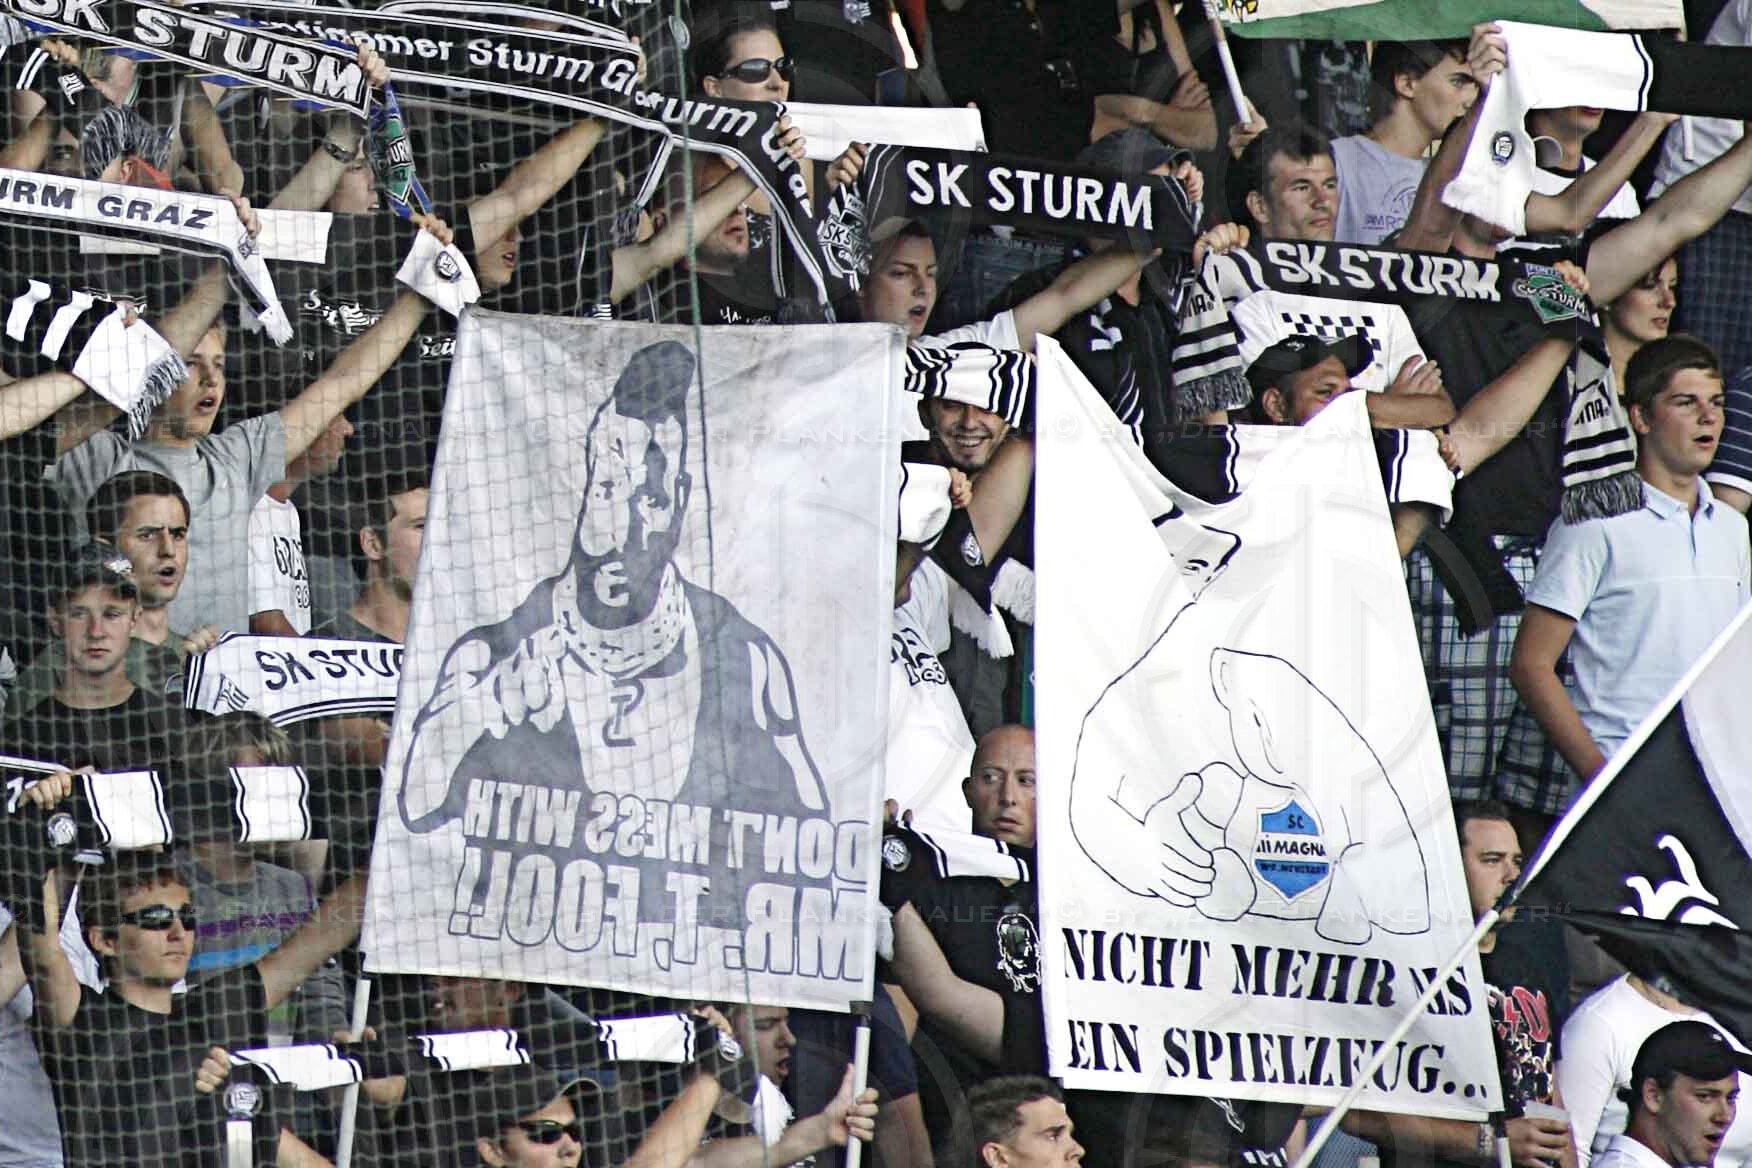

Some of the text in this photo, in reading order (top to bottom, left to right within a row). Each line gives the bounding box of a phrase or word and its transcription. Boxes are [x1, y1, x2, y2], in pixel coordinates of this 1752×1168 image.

[135, 9, 370, 117] STURM
[469, 38, 595, 85] Sturm
[96, 193, 217, 231] GRAZ
[908, 159, 1157, 231] SK STURM
[1268, 243, 1500, 303] SK STURM
[254, 649, 315, 691] SK
[1286, 814, 1305, 830] SC
[1062, 926, 1211, 991] NICHT
[1230, 943, 1397, 1006] MEHR
[1068, 1020, 1489, 1100] EIN SPIELZEUG...
